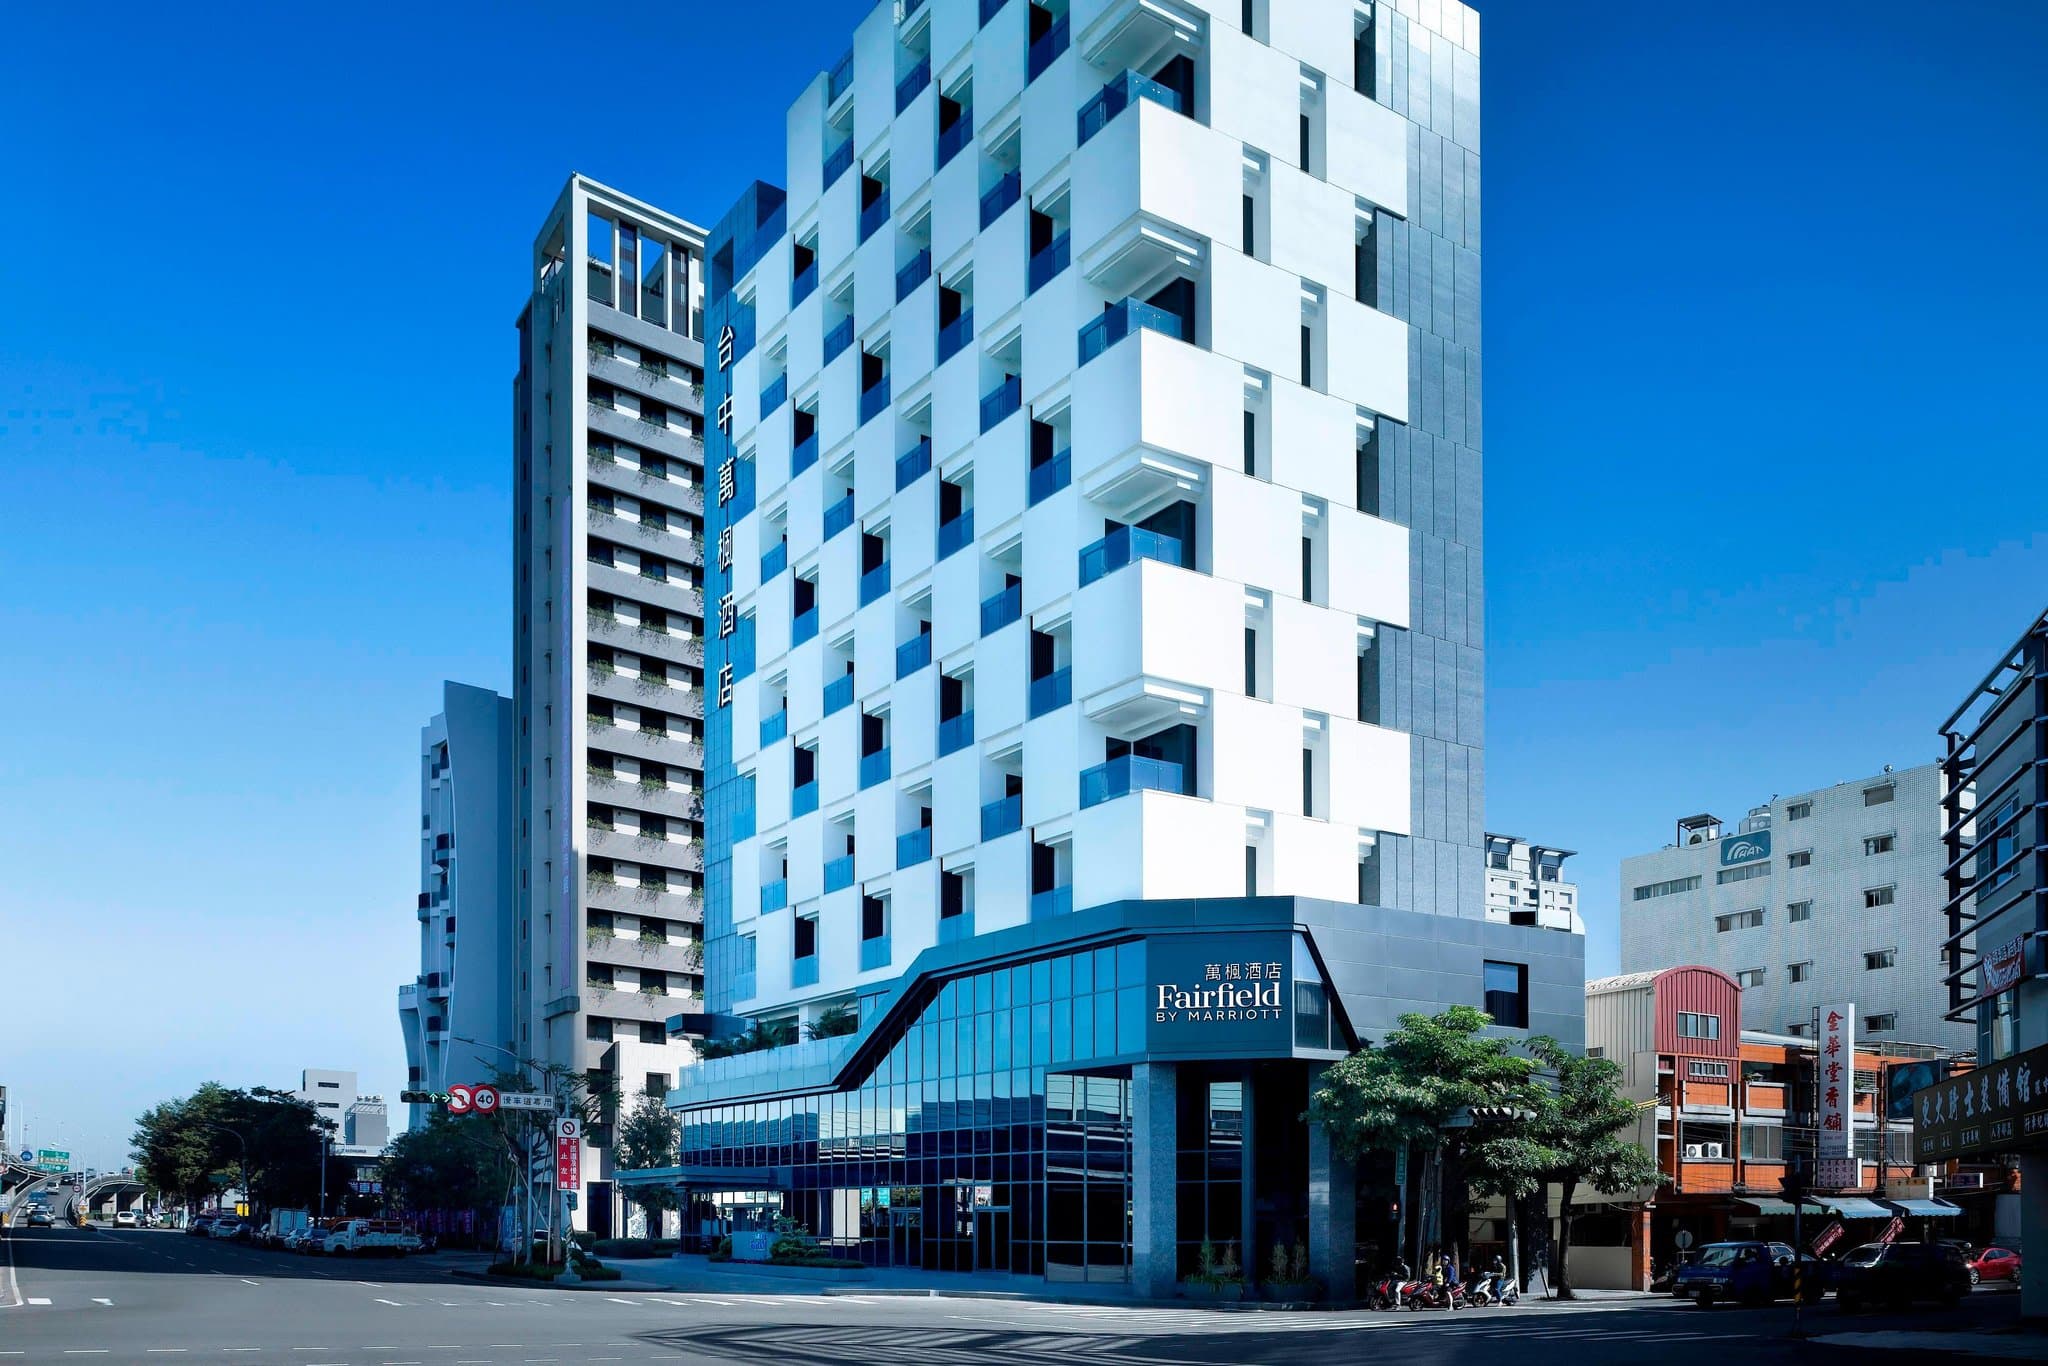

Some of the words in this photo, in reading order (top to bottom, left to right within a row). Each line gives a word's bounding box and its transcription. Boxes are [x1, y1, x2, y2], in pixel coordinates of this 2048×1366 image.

[717, 325, 735, 709] 台中萬楓酒店
[1204, 961, 1282, 981] 萬楓酒店
[1156, 981, 1282, 1010] Fairfield
[1156, 1011, 1178, 1022] BY
[1188, 1009, 1283, 1021] MARRIOTT
[477, 1094, 494, 1105] 40
